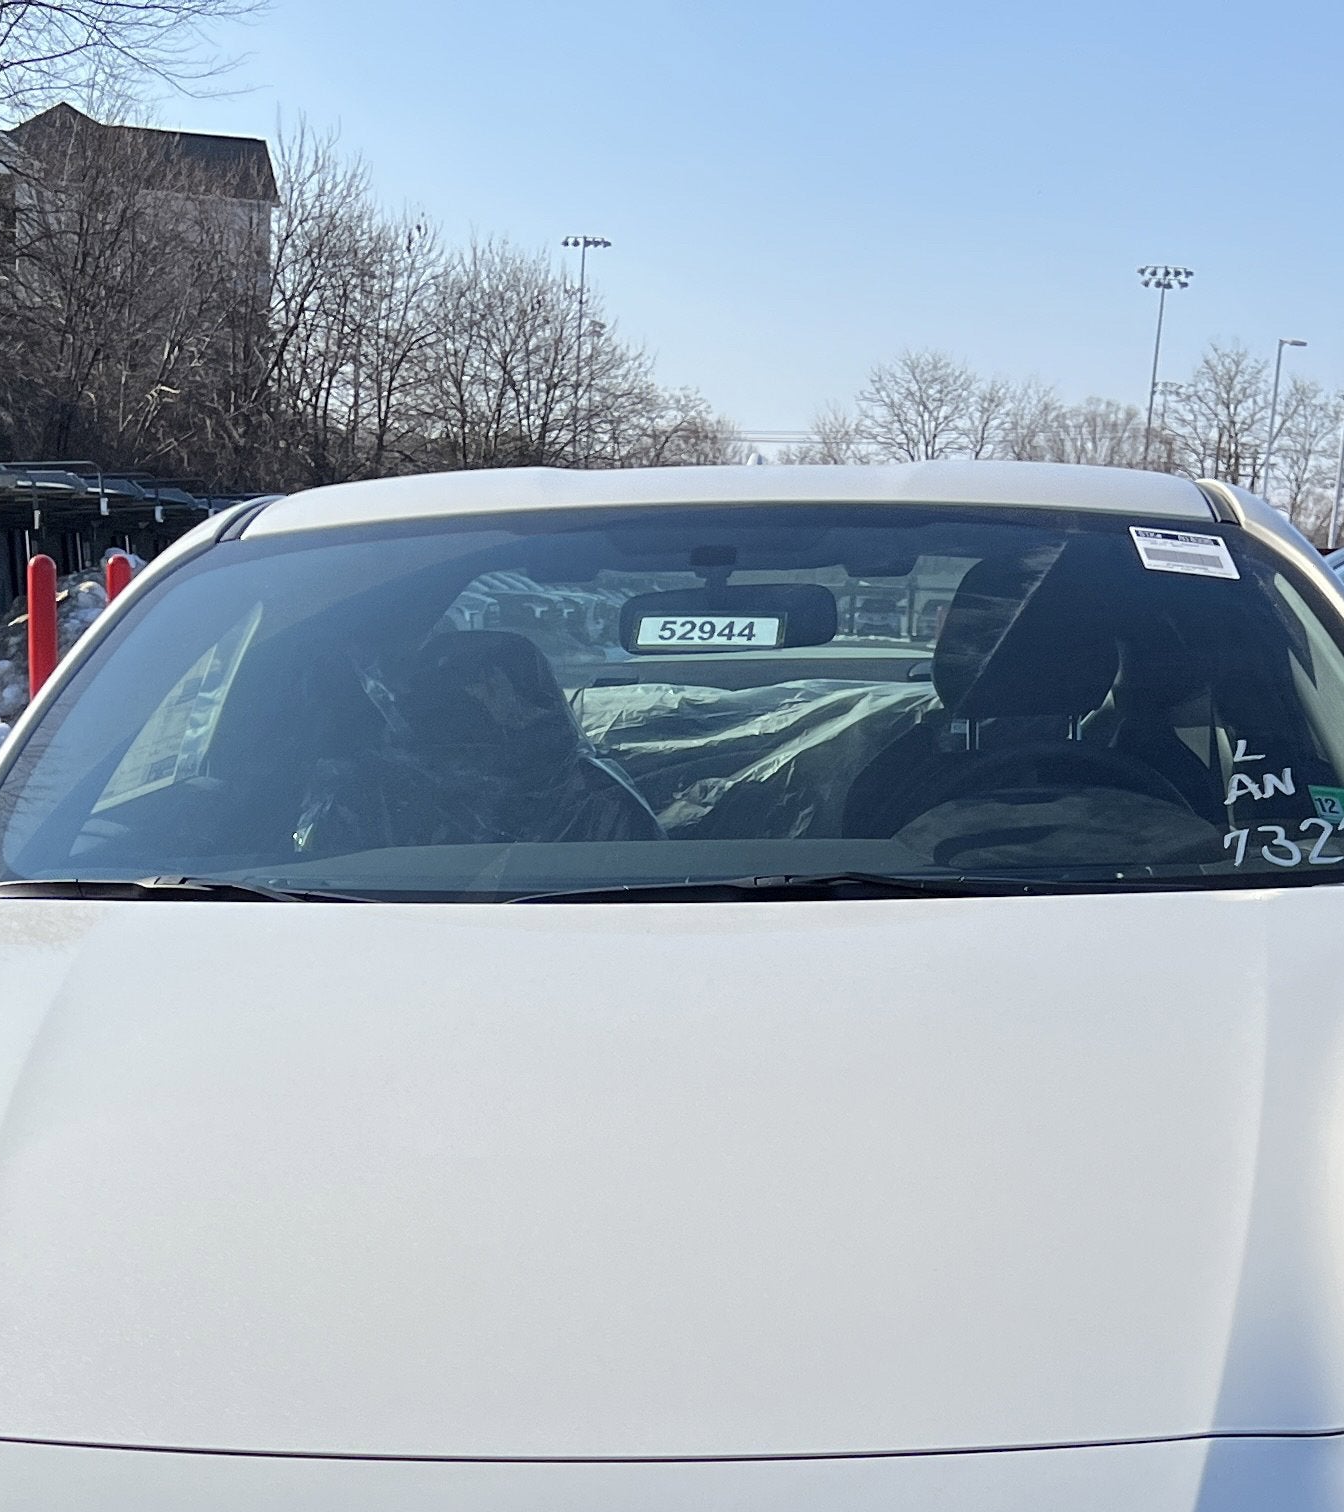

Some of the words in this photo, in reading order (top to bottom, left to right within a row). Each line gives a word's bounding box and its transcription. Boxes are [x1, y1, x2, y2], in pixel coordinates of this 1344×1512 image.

[658, 620, 756, 641] 52944
[1223, 767, 1296, 805] AN
[1314, 797, 1340, 814] 12
